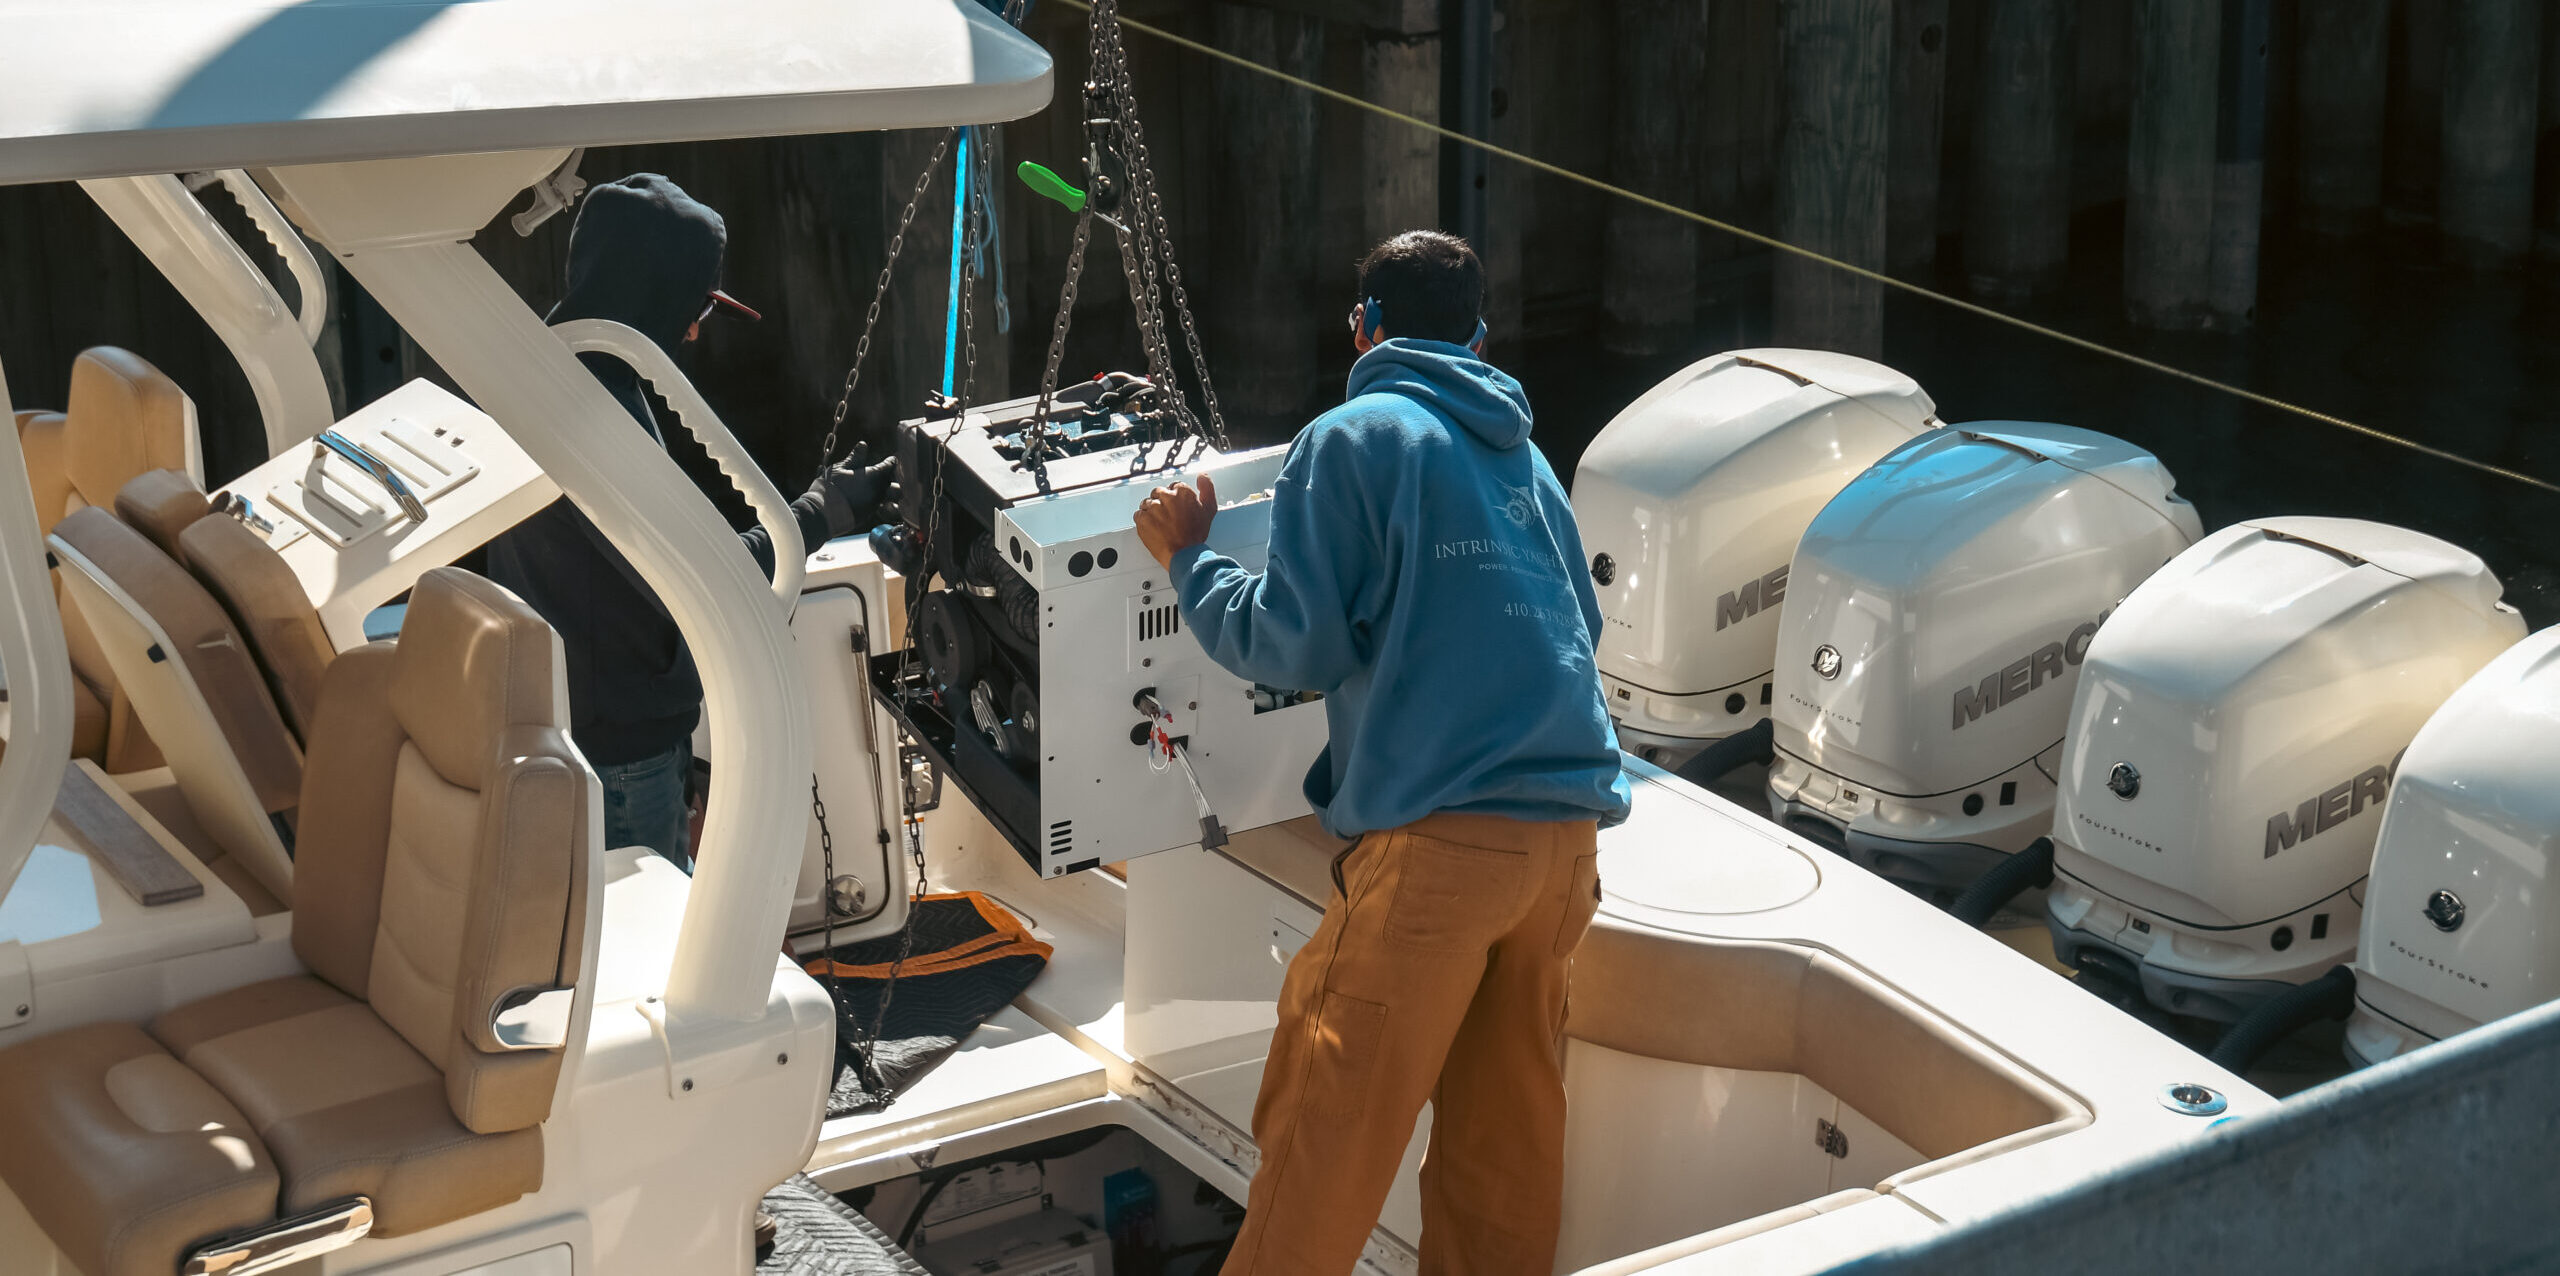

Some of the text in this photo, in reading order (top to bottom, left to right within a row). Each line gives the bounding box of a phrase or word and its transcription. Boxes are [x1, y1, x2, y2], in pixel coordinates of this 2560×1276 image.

[1435, 538, 1521, 559] INTRINSIC
[1716, 563, 1790, 632] ME
[1789, 693, 1863, 727] FourStroke
[2079, 813, 2163, 853] FourStroke
[2389, 940, 2490, 990] FourStroke
